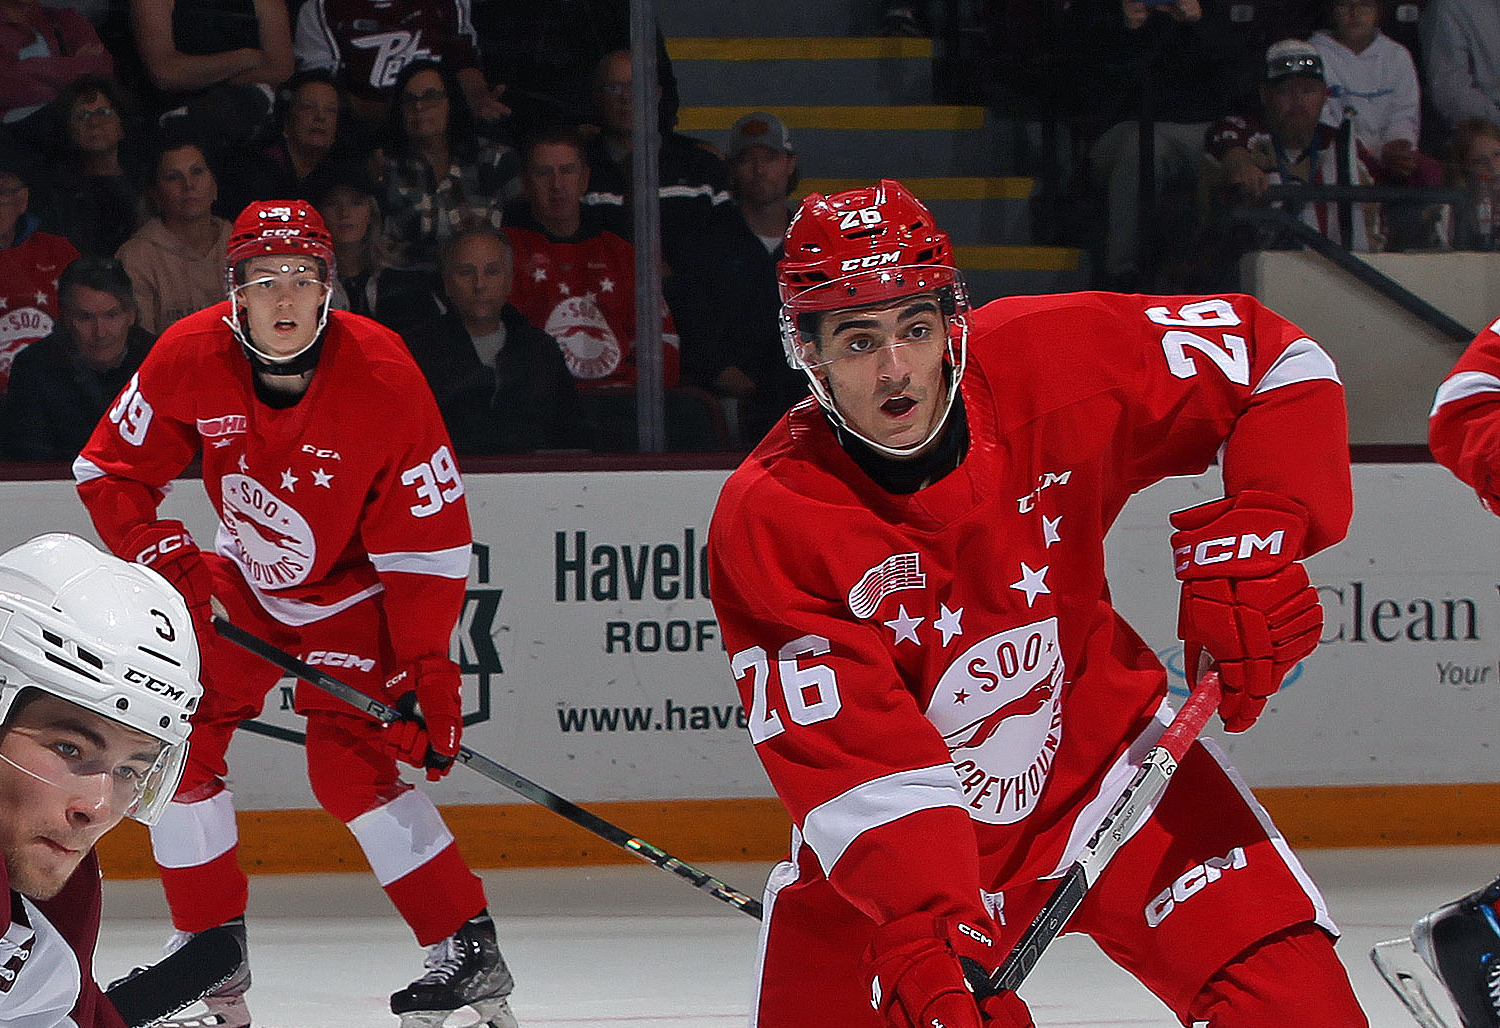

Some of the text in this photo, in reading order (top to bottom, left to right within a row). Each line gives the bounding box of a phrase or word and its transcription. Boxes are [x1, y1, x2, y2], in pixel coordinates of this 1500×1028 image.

[262, 229, 301, 237] CCM
[837, 205, 883, 230] 26
[841, 251, 901, 273] CCM
[9, 311, 40, 331] SOO
[1144, 299, 1250, 386] 26
[401, 445, 466, 518] 39
[241, 481, 278, 519] SOO
[1174, 530, 1285, 566] CCM
[151, 609, 176, 641] 3
[1318, 582, 1480, 644] Clean
[306, 650, 376, 672] CCM
[968, 633, 1042, 692] SOO
[1437, 661, 1491, 686] Your
[124, 666, 186, 702] CCM
[385, 671, 408, 688] CCM
[731, 634, 842, 746] 26
[1145, 846, 1248, 928] CCM
[957, 922, 993, 947] CCM
